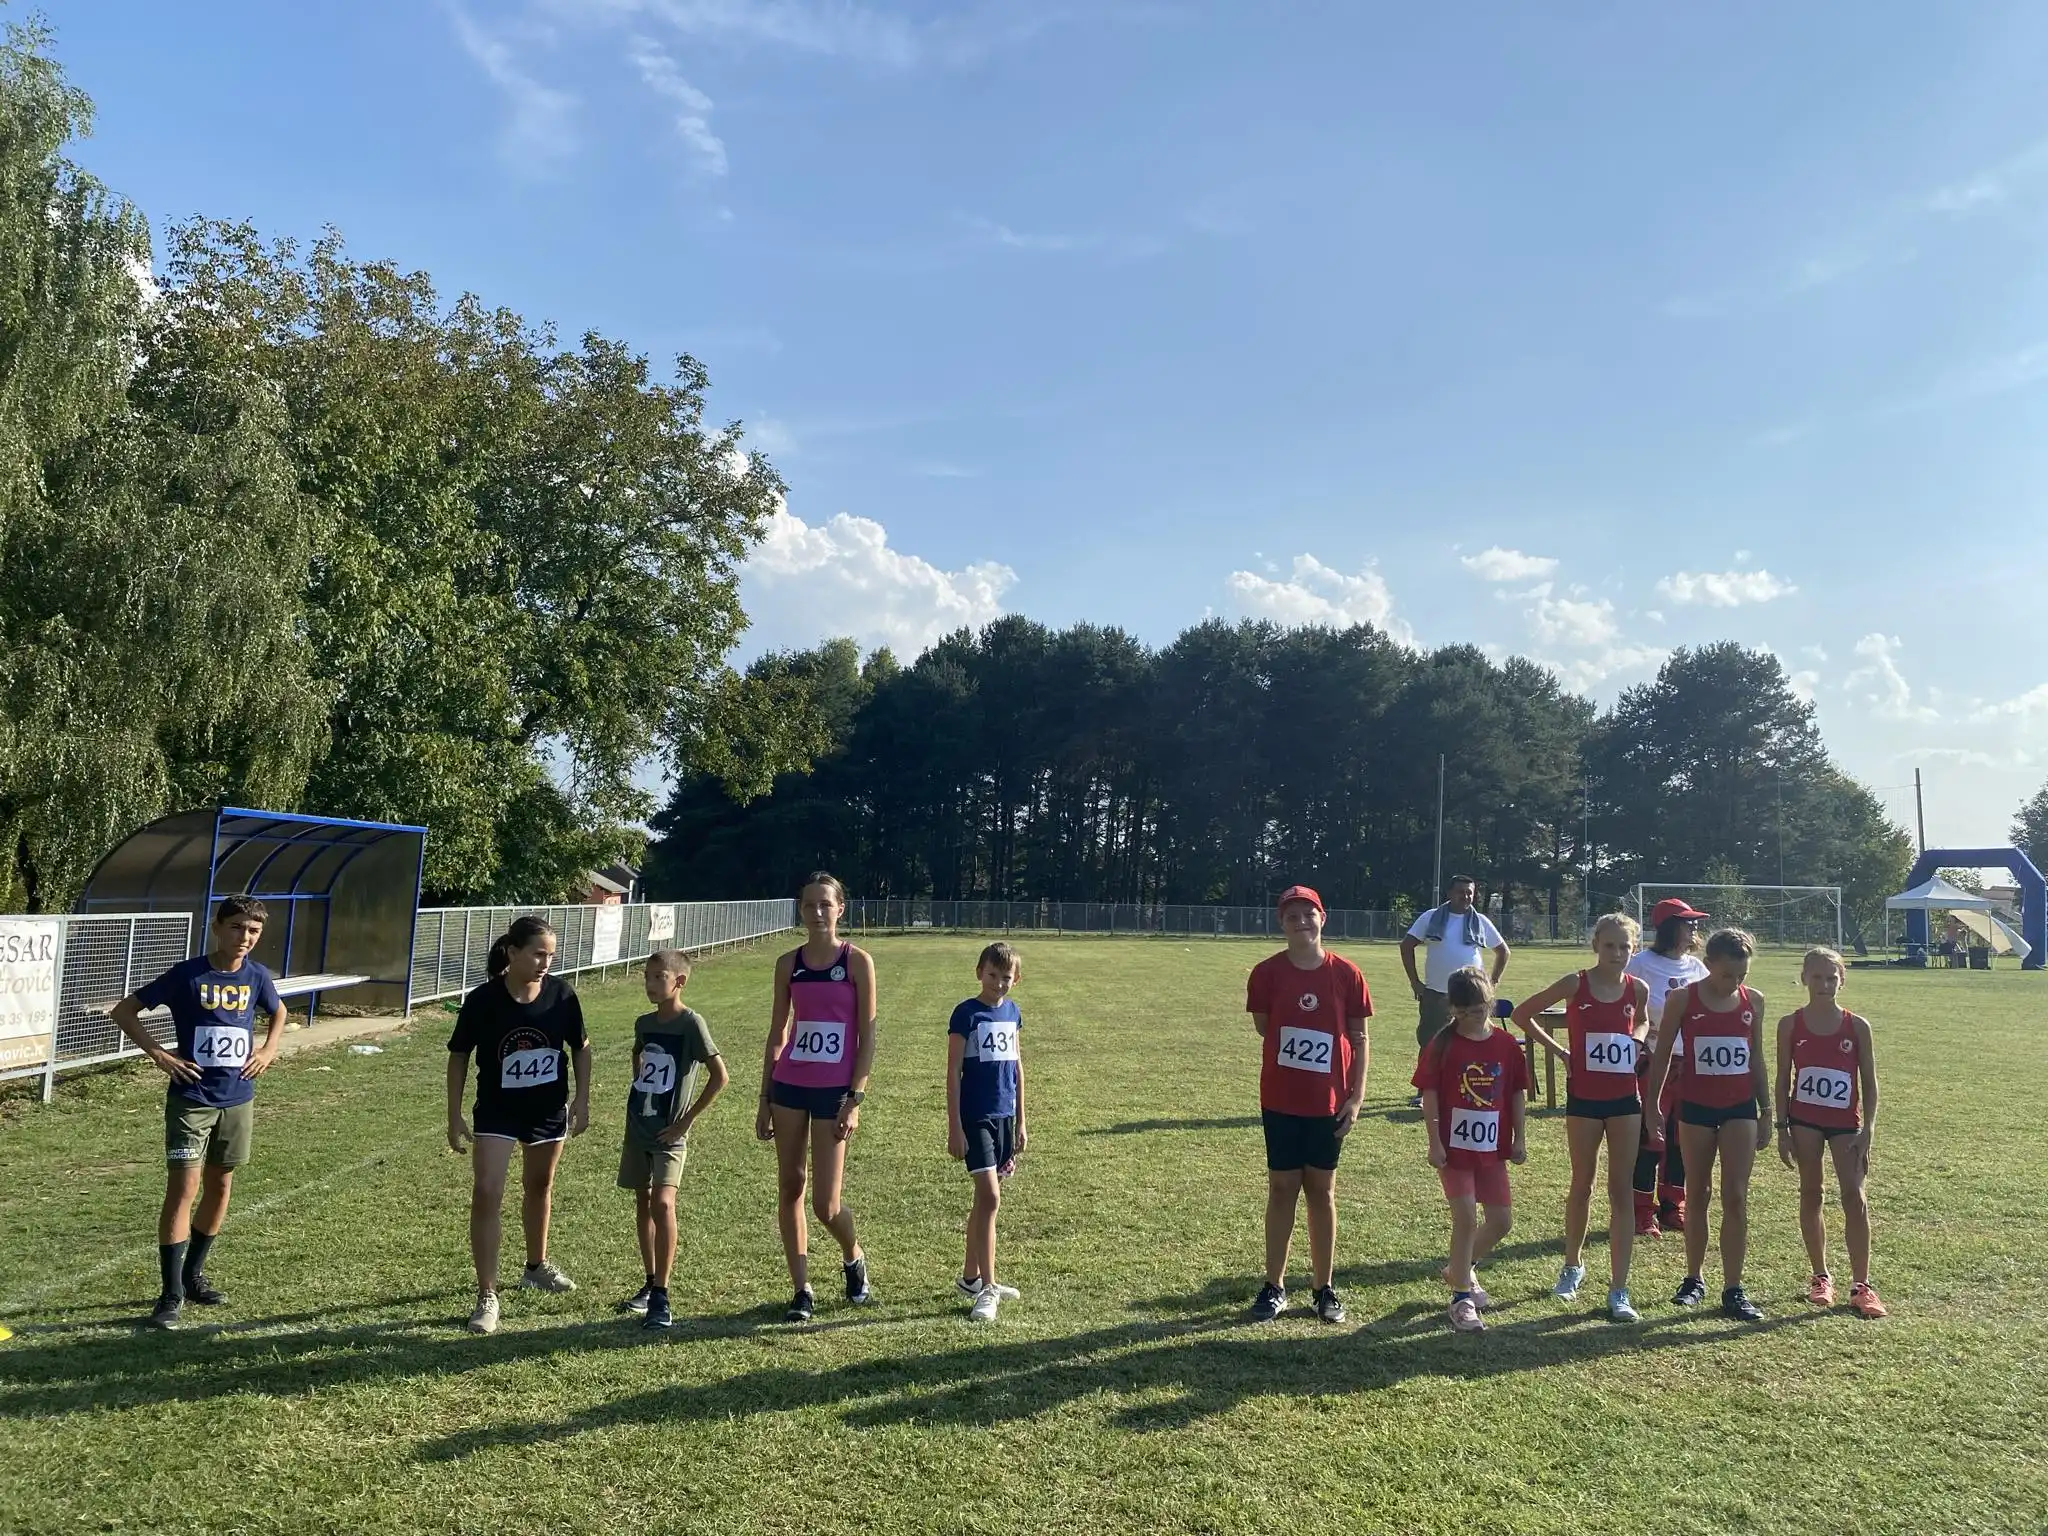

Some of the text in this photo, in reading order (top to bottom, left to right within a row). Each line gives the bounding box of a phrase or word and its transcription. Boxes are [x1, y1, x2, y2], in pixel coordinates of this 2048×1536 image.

[197, 1036, 246, 1059] 420
[796, 1031, 841, 1054] 403
[981, 1032, 1015, 1053] 431
[1282, 1037, 1330, 1064] 422
[1589, 1042, 1631, 1065] 401
[505, 1055, 555, 1080] 442
[1698, 1046, 1747, 1068] 405
[642, 1062, 670, 1086] 21
[1800, 1075, 1848, 1101] 402
[1453, 1119, 1497, 1144] 400
